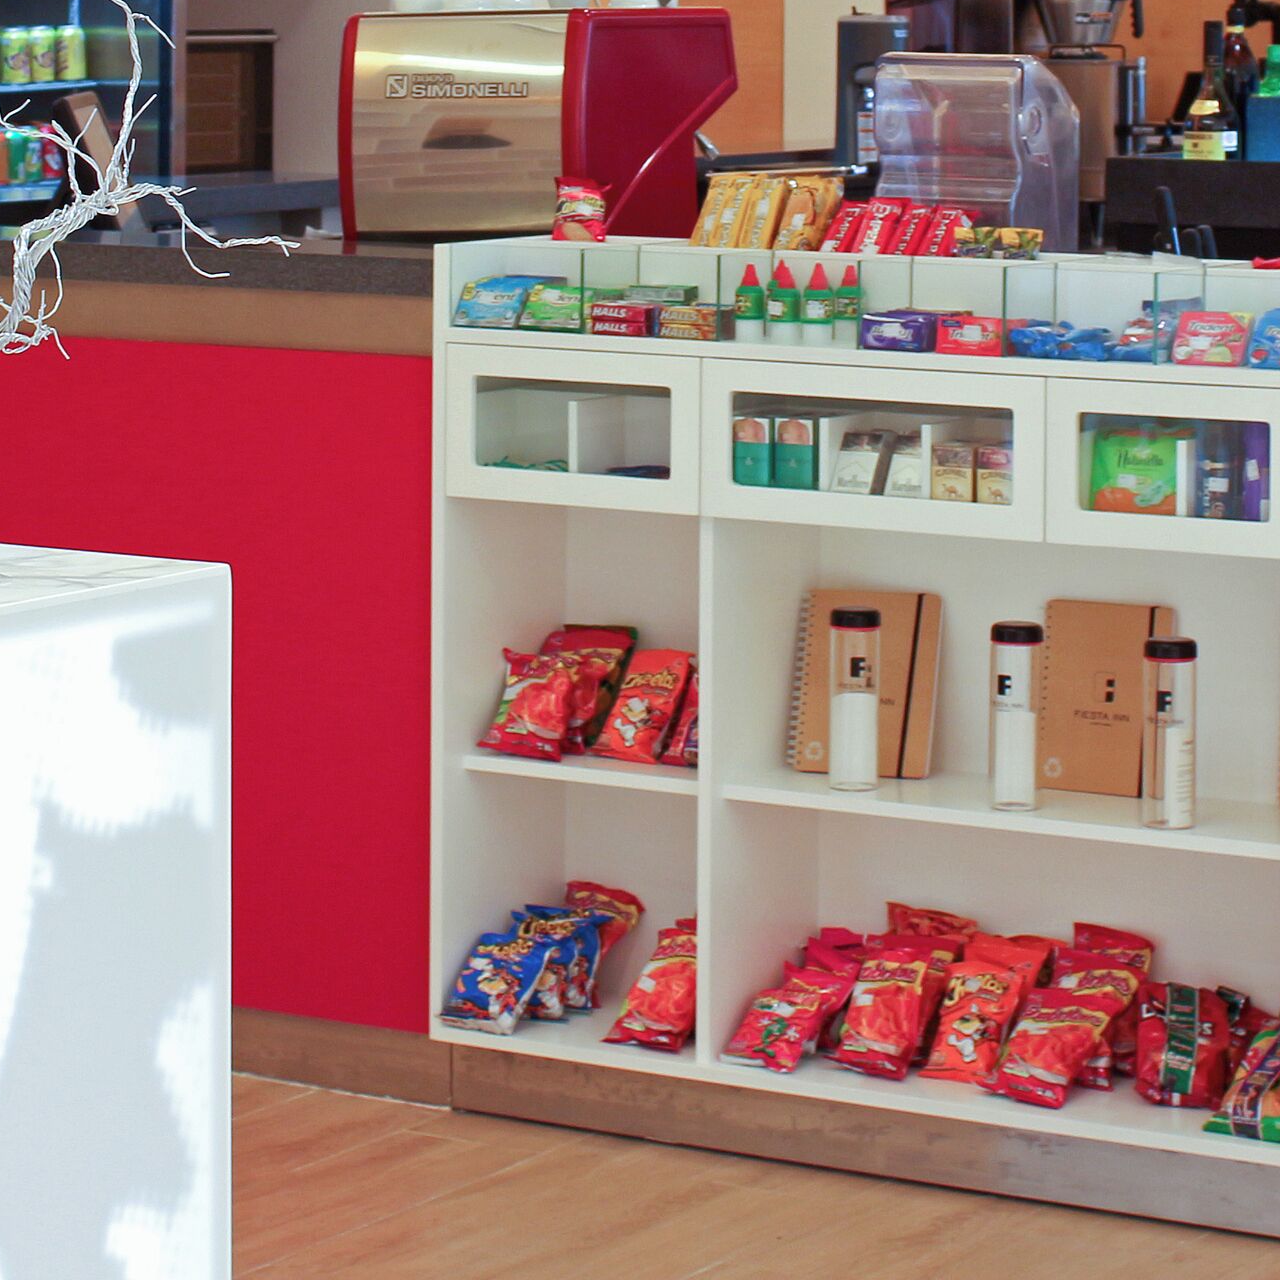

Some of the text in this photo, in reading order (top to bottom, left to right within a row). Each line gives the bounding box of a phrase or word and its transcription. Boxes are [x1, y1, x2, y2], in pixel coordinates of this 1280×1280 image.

[411, 82, 529, 98] SIMONELLI
[591, 306, 627, 319] HALLS
[660, 310, 699, 321] HALLS
[593, 321, 628, 333] HALLS
[660, 326, 700, 337] HALLS
